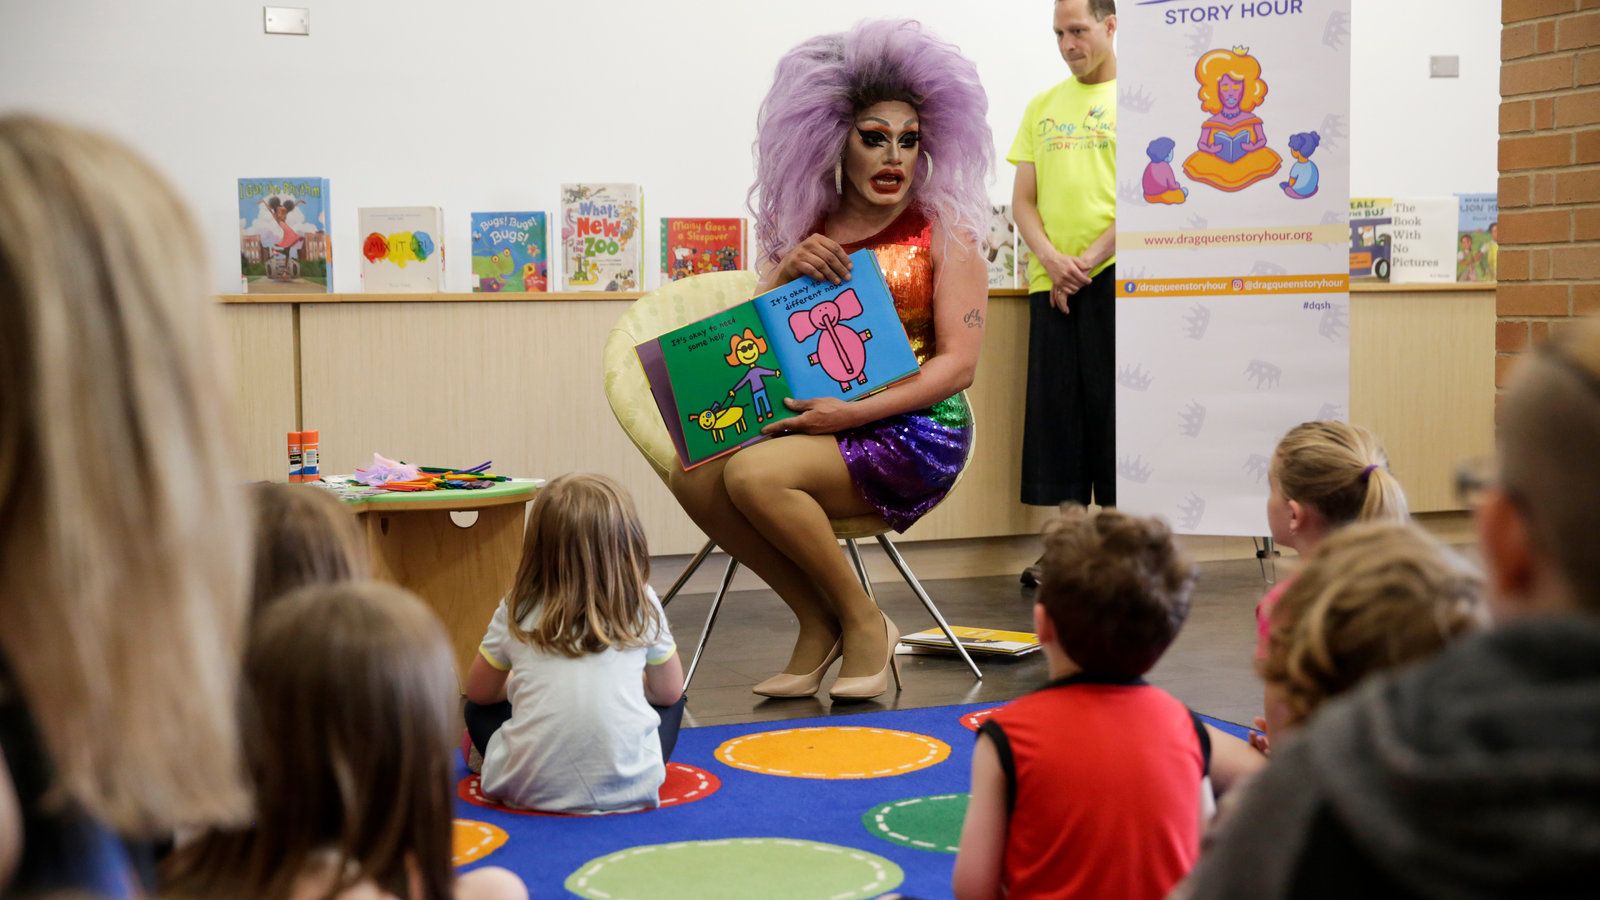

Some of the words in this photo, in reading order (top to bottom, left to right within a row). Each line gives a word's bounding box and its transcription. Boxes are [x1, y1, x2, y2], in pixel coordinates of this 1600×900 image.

[1165, 4, 1233, 25] STORY
[1241, 0, 1303, 18] HOUR
[579, 201, 619, 218] What's
[1393, 203, 1415, 213] The
[480, 216, 507, 232] Bugs!
[509, 216, 537, 230] Bugs!
[577, 217, 621, 238] New
[1393, 216, 1421, 226] Book
[490, 230, 529, 246] Bugs!
[1144, 230, 1313, 246] www.dragqueenstoryhour.org
[1393, 230, 1421, 240] With
[395, 240, 406, 253] IT
[1392, 244, 1408, 253] No
[1392, 257, 1439, 267] Pictures
[1244, 278, 1344, 291] @dragqueenstoryhour
[770, 294, 788, 307] It's
[789, 285, 809, 298] okay
[785, 288, 822, 311] different
[1303, 301, 1331, 311] #dqsh
[671, 335, 687, 347] It's
[688, 328, 707, 340] okay
[719, 315, 736, 328] need
[688, 340, 709, 352] some
